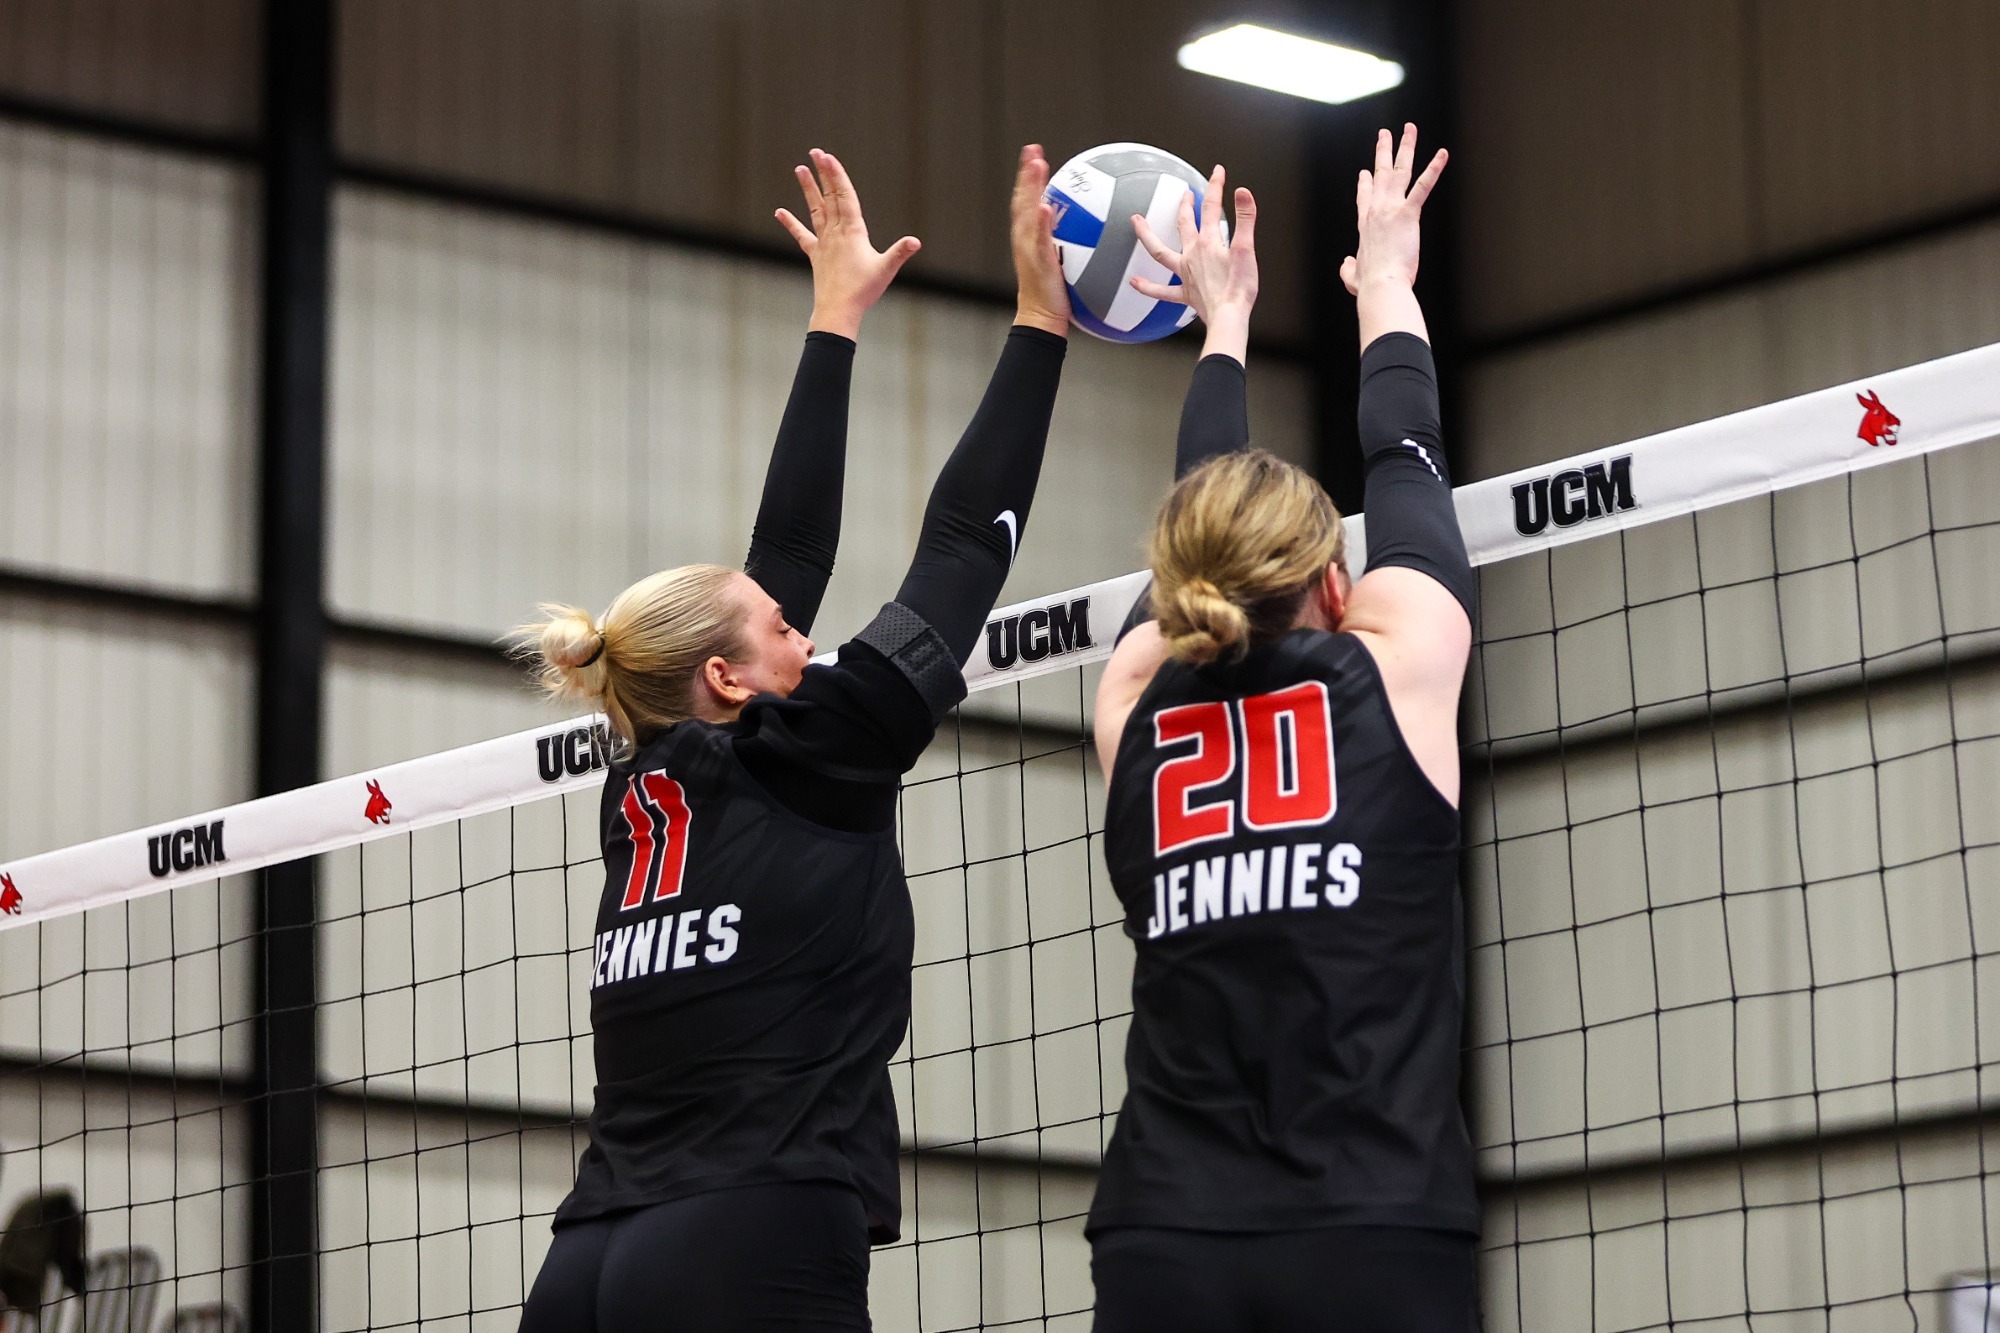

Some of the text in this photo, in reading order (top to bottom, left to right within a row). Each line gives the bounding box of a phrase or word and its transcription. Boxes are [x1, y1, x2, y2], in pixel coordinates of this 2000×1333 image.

[1511, 453, 1637, 537] UCM
[986, 596, 1093, 671] UCM
[1153, 679, 1337, 858] 20
[147, 819, 227, 878] UCM
[620, 768, 692, 912] 11
[1147, 842, 1362, 939] JENNIES
